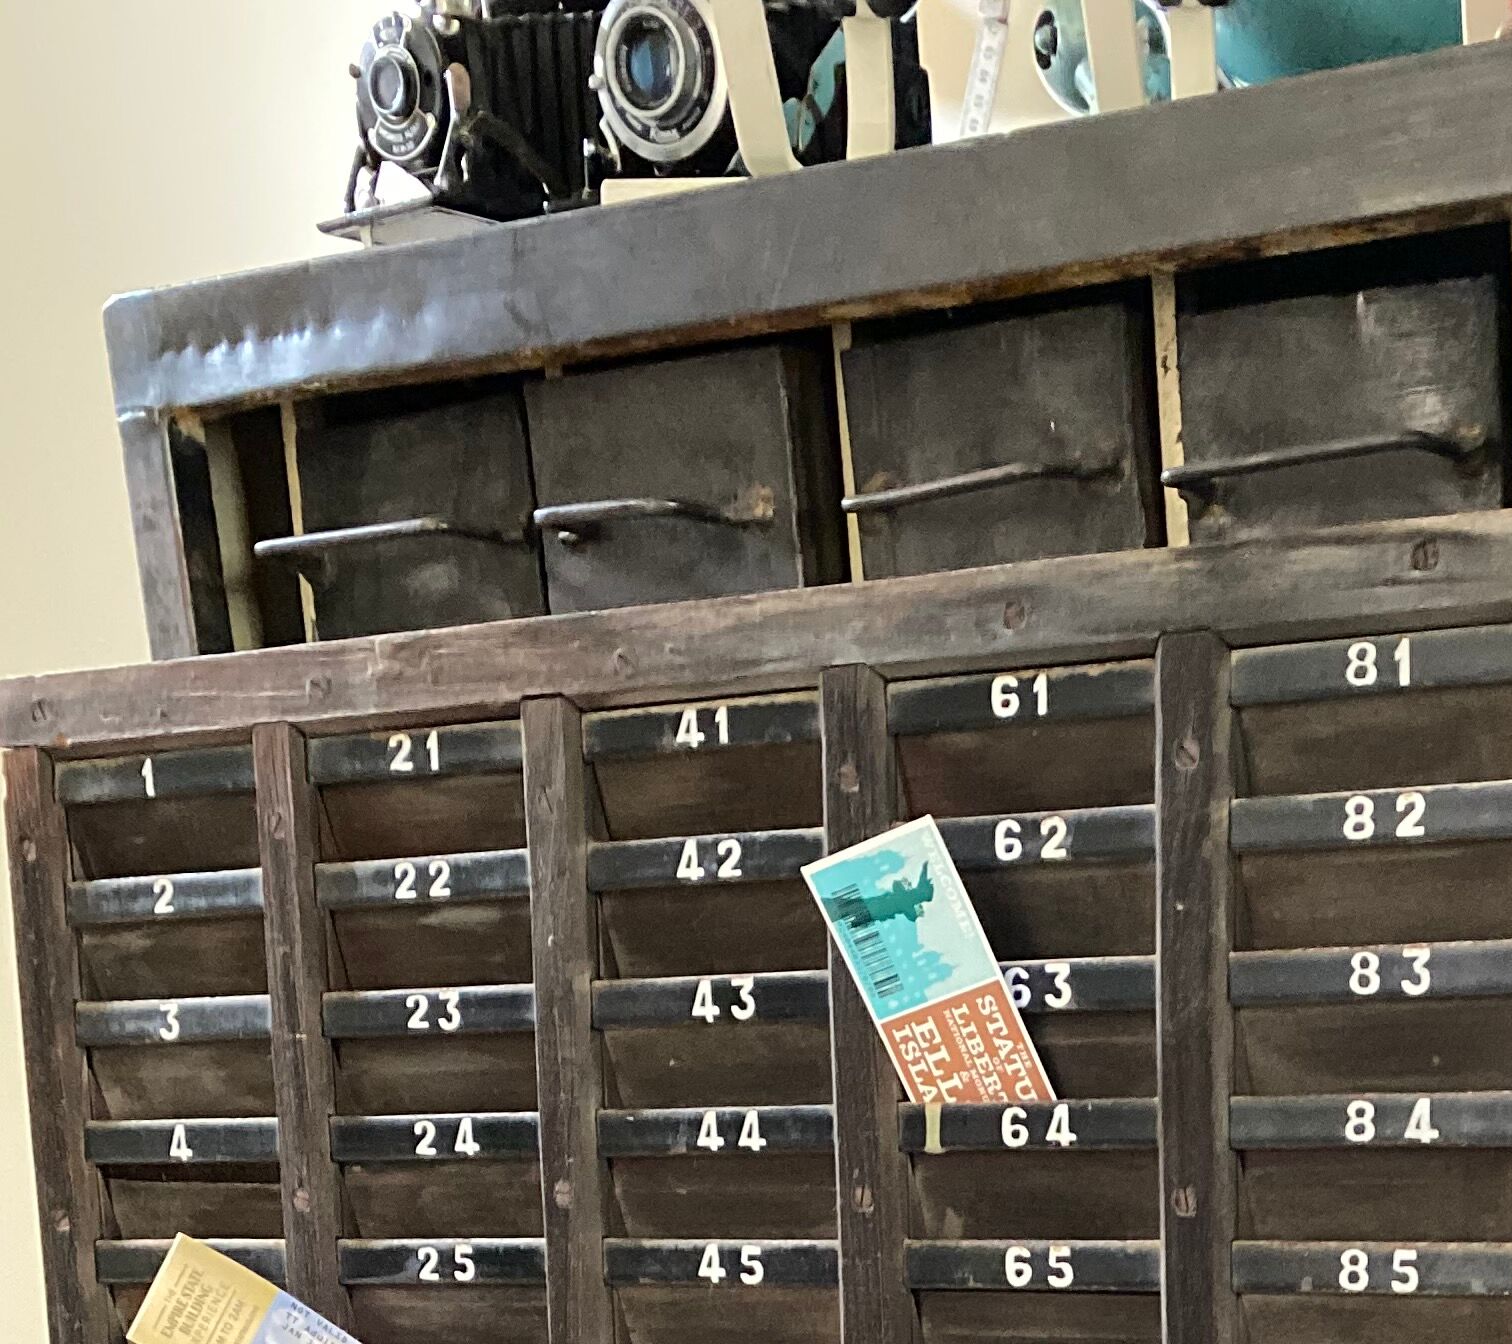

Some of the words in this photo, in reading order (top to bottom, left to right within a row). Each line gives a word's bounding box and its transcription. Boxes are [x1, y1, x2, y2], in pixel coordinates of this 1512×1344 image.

[1345, 637, 1411, 687] 81
[990, 673, 1048, 719] 61
[678, 706, 729, 745] 41
[388, 730, 440, 772] 21
[141, 757, 156, 798] 1
[1342, 791, 1426, 841] 82
[678, 838, 742, 879] 42
[994, 816, 1068, 862] 62
[152, 880, 175, 915] 2
[394, 861, 451, 900] 22
[691, 978, 756, 1024] 43
[1002, 963, 1073, 1010] 63
[158, 1004, 180, 1042] 3
[405, 993, 462, 1032] 23
[906, 1016, 971, 1101] ELL
[939, 1009, 976, 1067] NATIONAL
[972, 995, 1039, 1101] STATU
[1014, 1042, 1033, 1068] THE
[886, 1024, 946, 1101] ISLA
[958, 1071, 973, 1082] &
[1344, 1098, 1440, 1143] 84
[169, 1124, 193, 1162] 4
[417, 1245, 476, 1282] 25
[699, 1244, 765, 1285] 45
[1004, 1246, 1074, 1288] 65
[1338, 1248, 1419, 1293] 85
[160, 1297, 188, 1338] EMPIRE
[179, 1266, 204, 1300] STATE
[178, 1282, 213, 1336] BUILDING
[289, 1300, 310, 1318] NOT
[315, 1319, 348, 1344] VALID
[220, 1320, 233, 1336] TO
[280, 1321, 303, 1339] JAN
